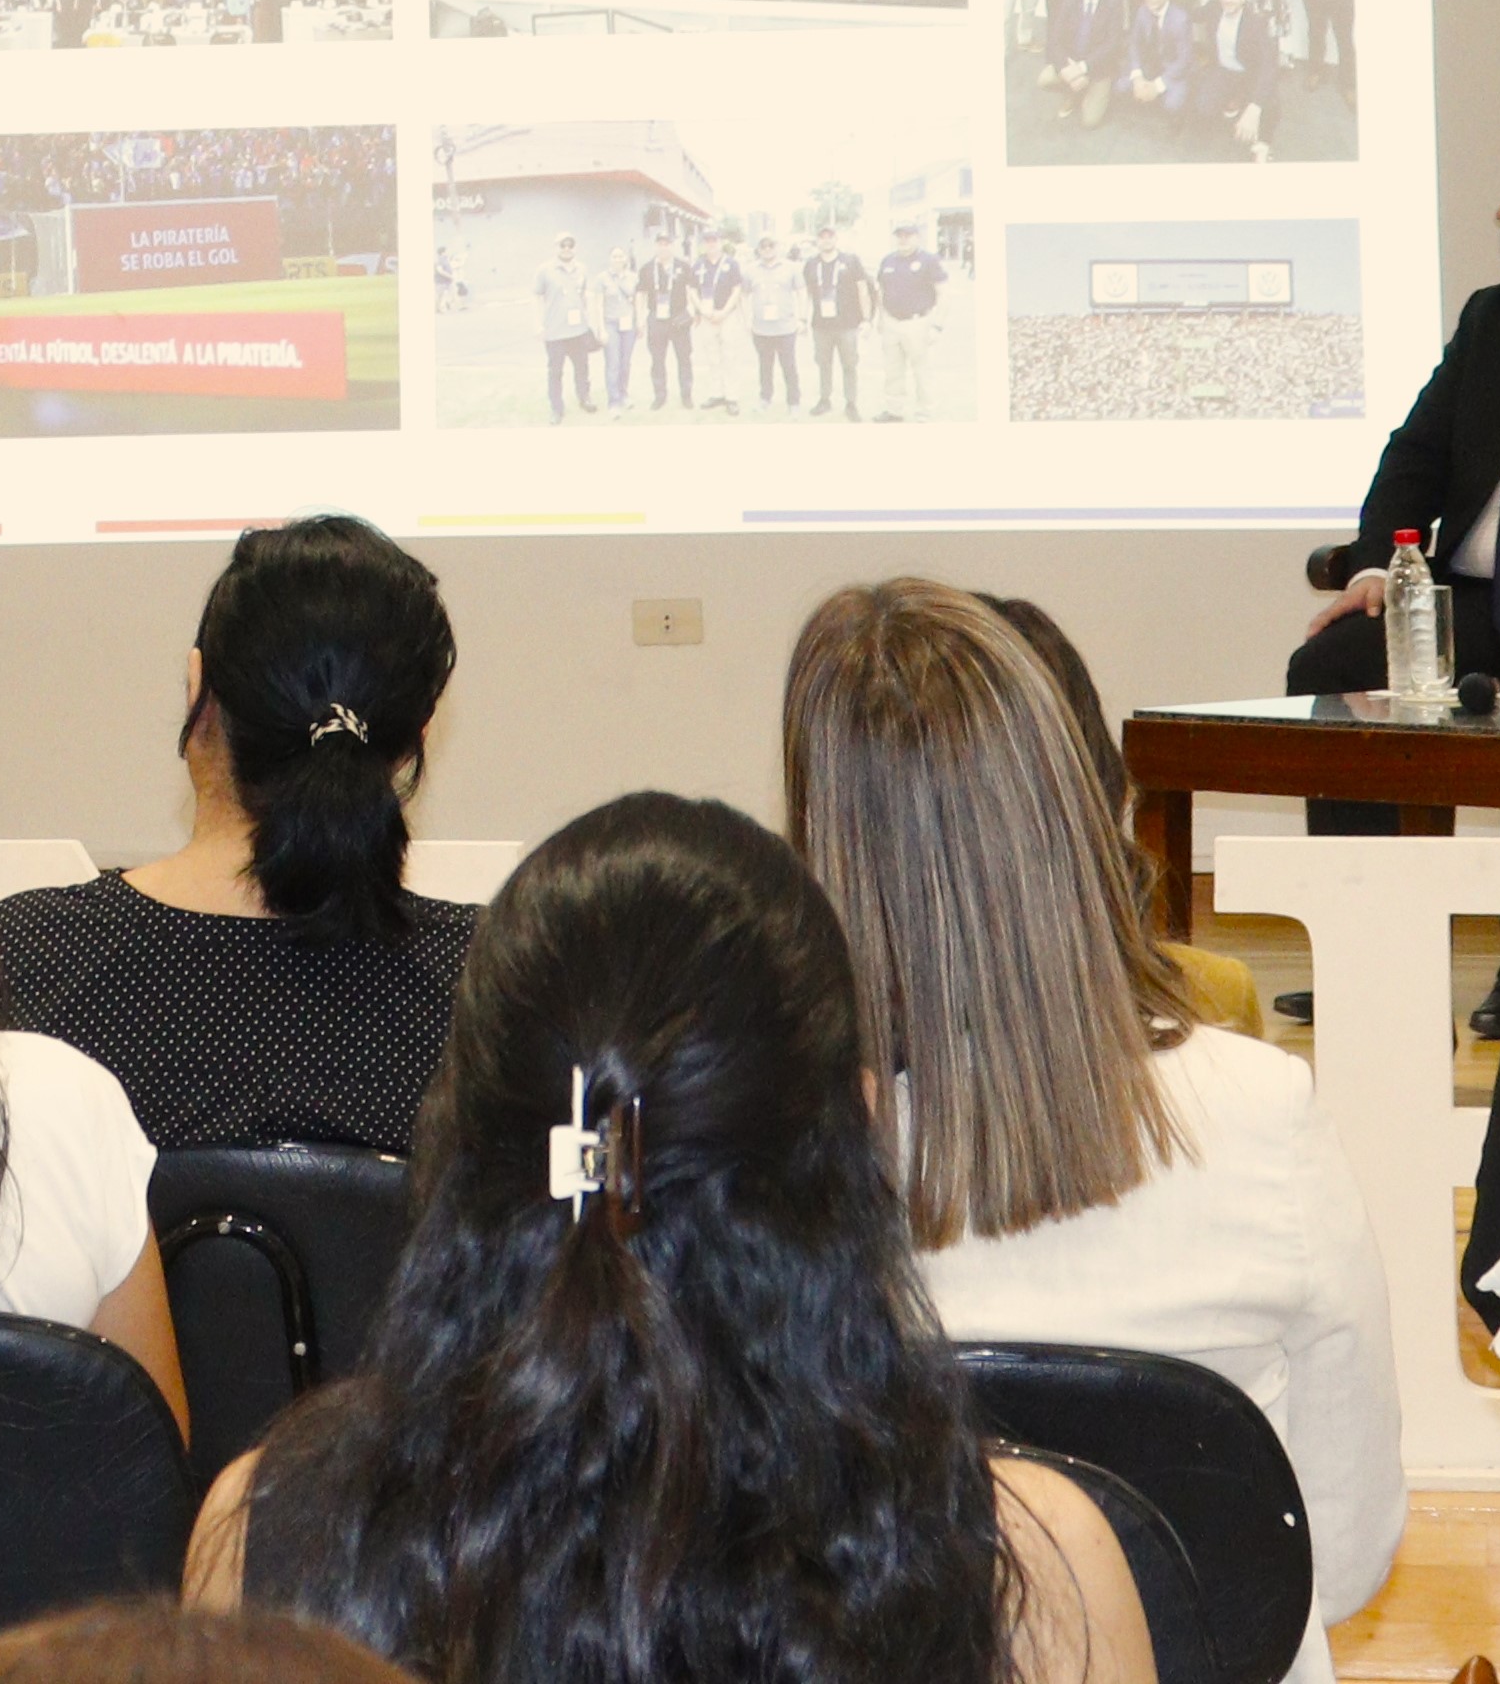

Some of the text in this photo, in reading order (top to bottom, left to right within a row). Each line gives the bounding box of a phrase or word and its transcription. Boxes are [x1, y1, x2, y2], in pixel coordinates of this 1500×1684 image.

[130, 223, 231, 248] LA PIRATERÍA
[120, 248, 239, 272] SE ROBA EL GOL
[183, 343, 194, 364] A
[197, 343, 215, 364] LA
